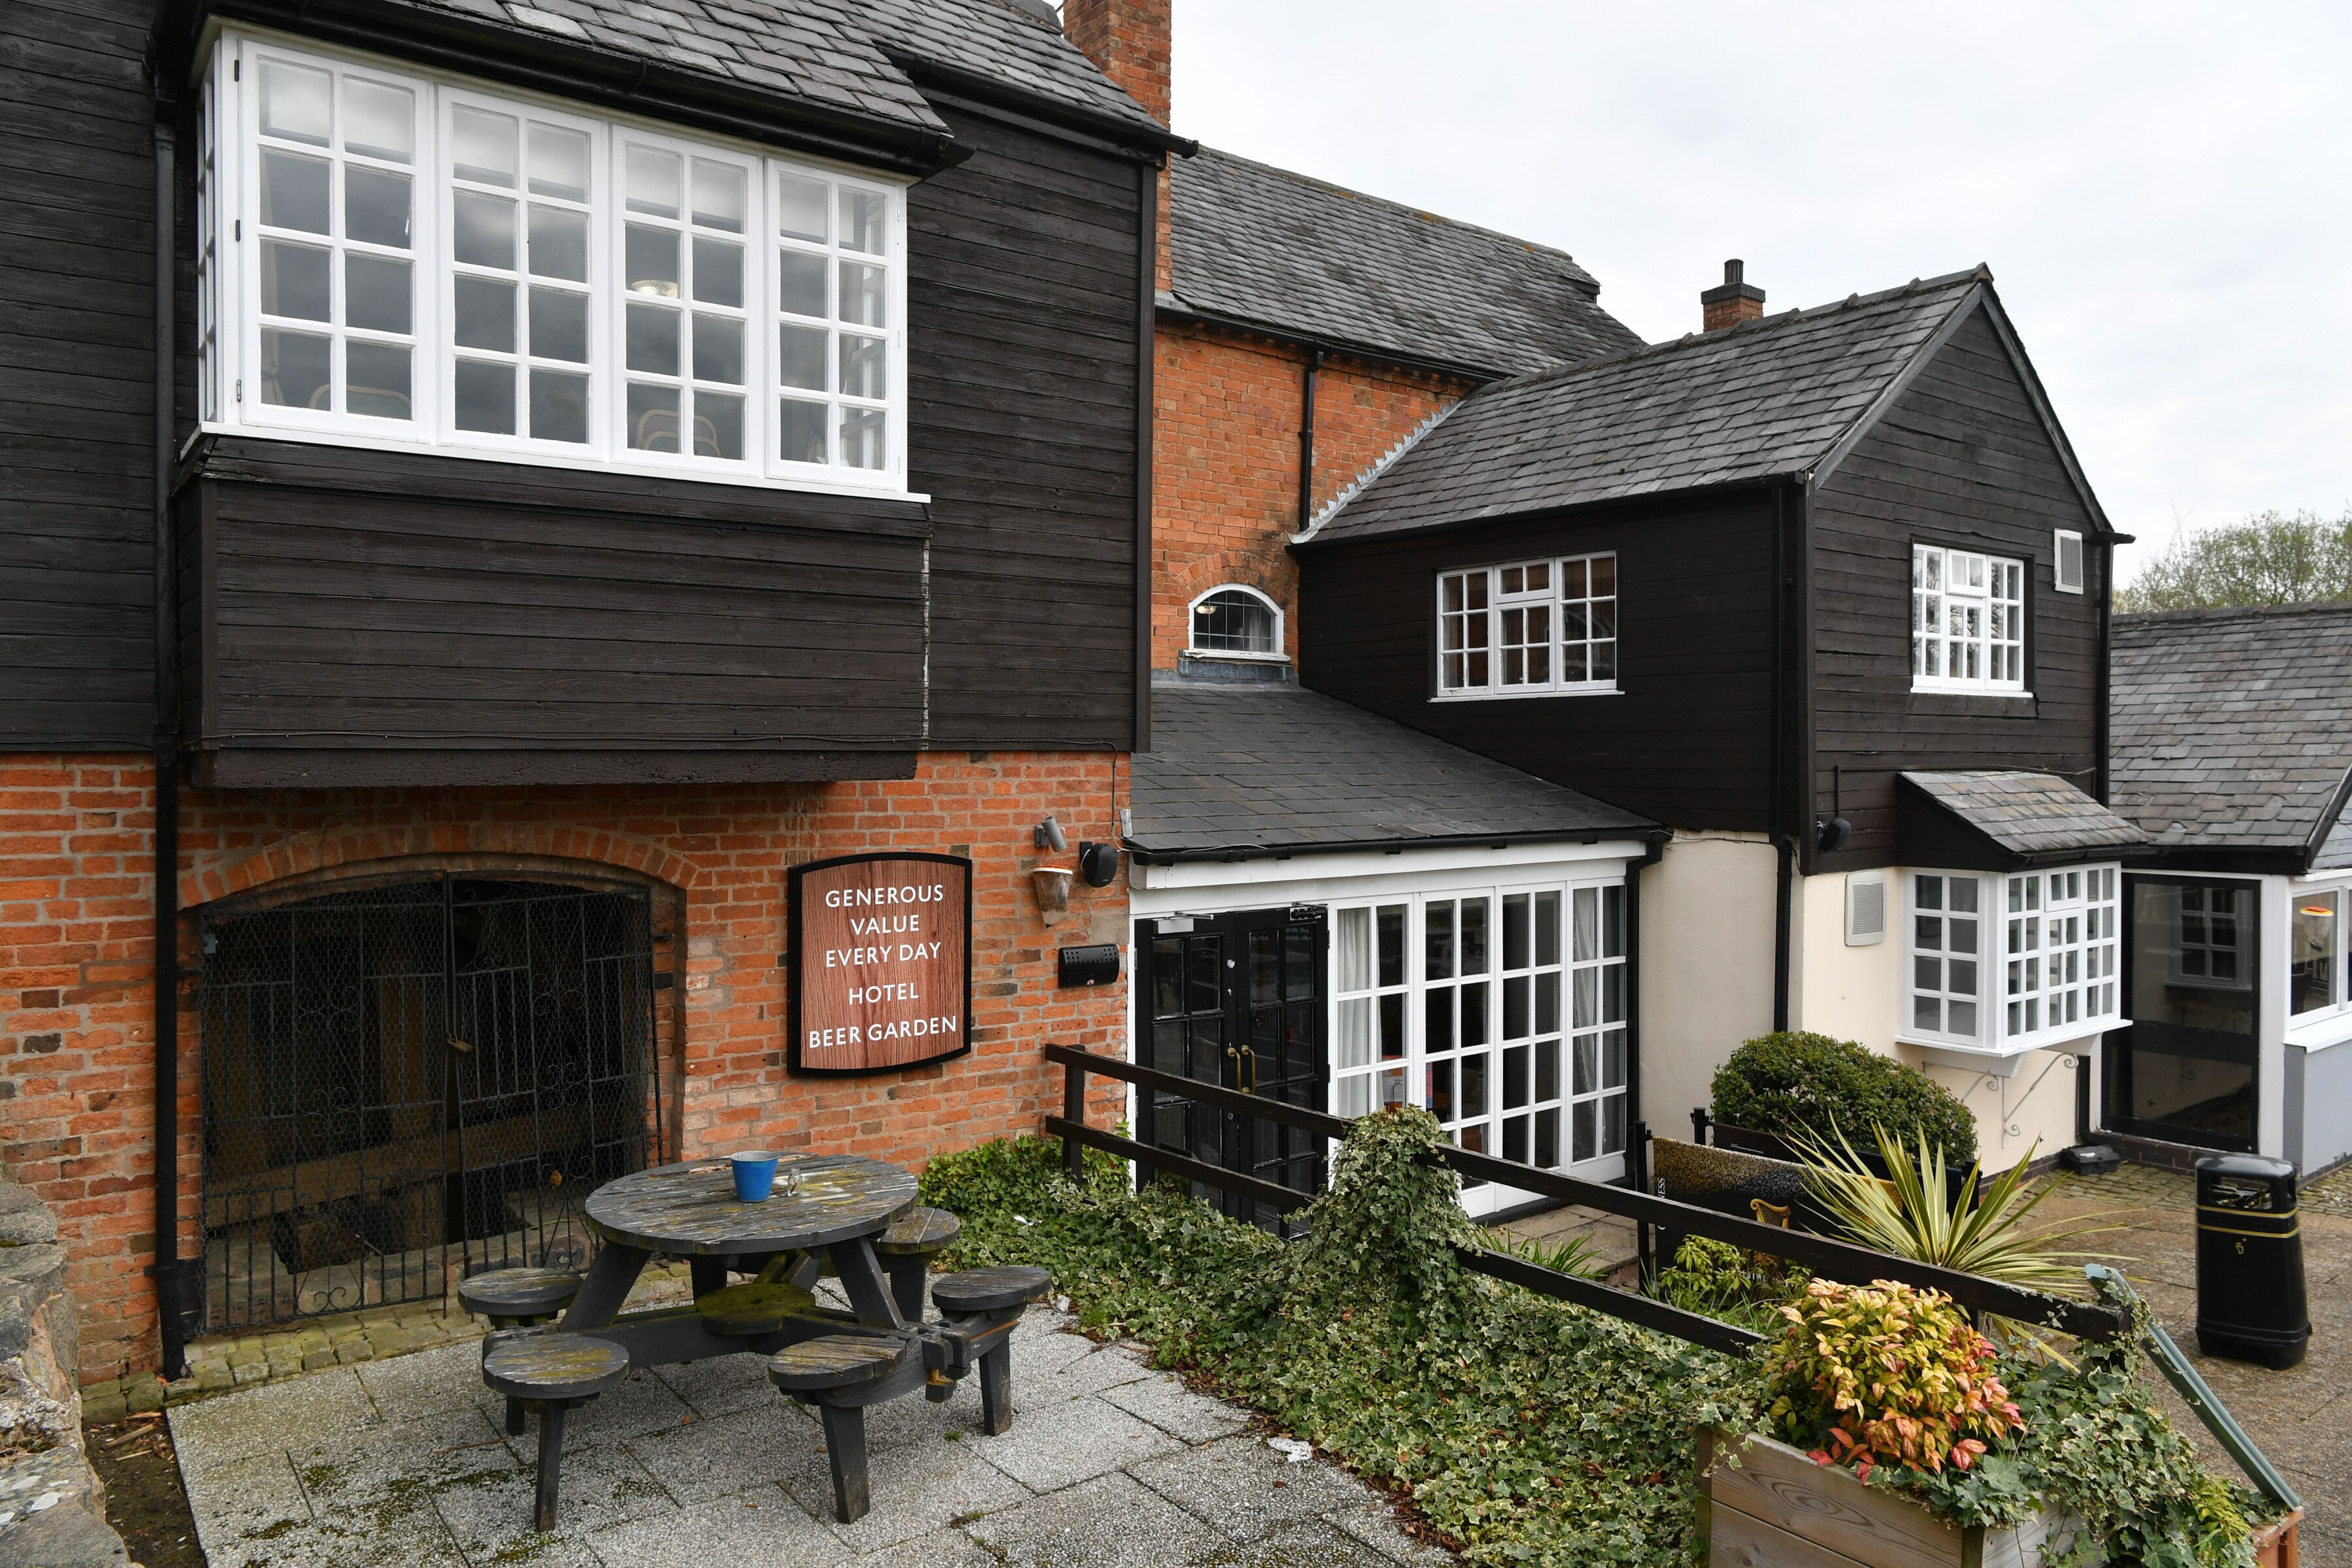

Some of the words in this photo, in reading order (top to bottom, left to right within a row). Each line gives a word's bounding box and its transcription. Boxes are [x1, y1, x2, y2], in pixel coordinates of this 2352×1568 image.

[825, 885, 943, 907] GENEROUS
[851, 914, 919, 936] VALUE
[826, 945, 892, 968] EVERY
[899, 941, 941, 962] DAY
[849, 983, 919, 1005] HOTEL
[809, 1026, 862, 1049] BEER
[868, 1015, 956, 1041] GARDEN
